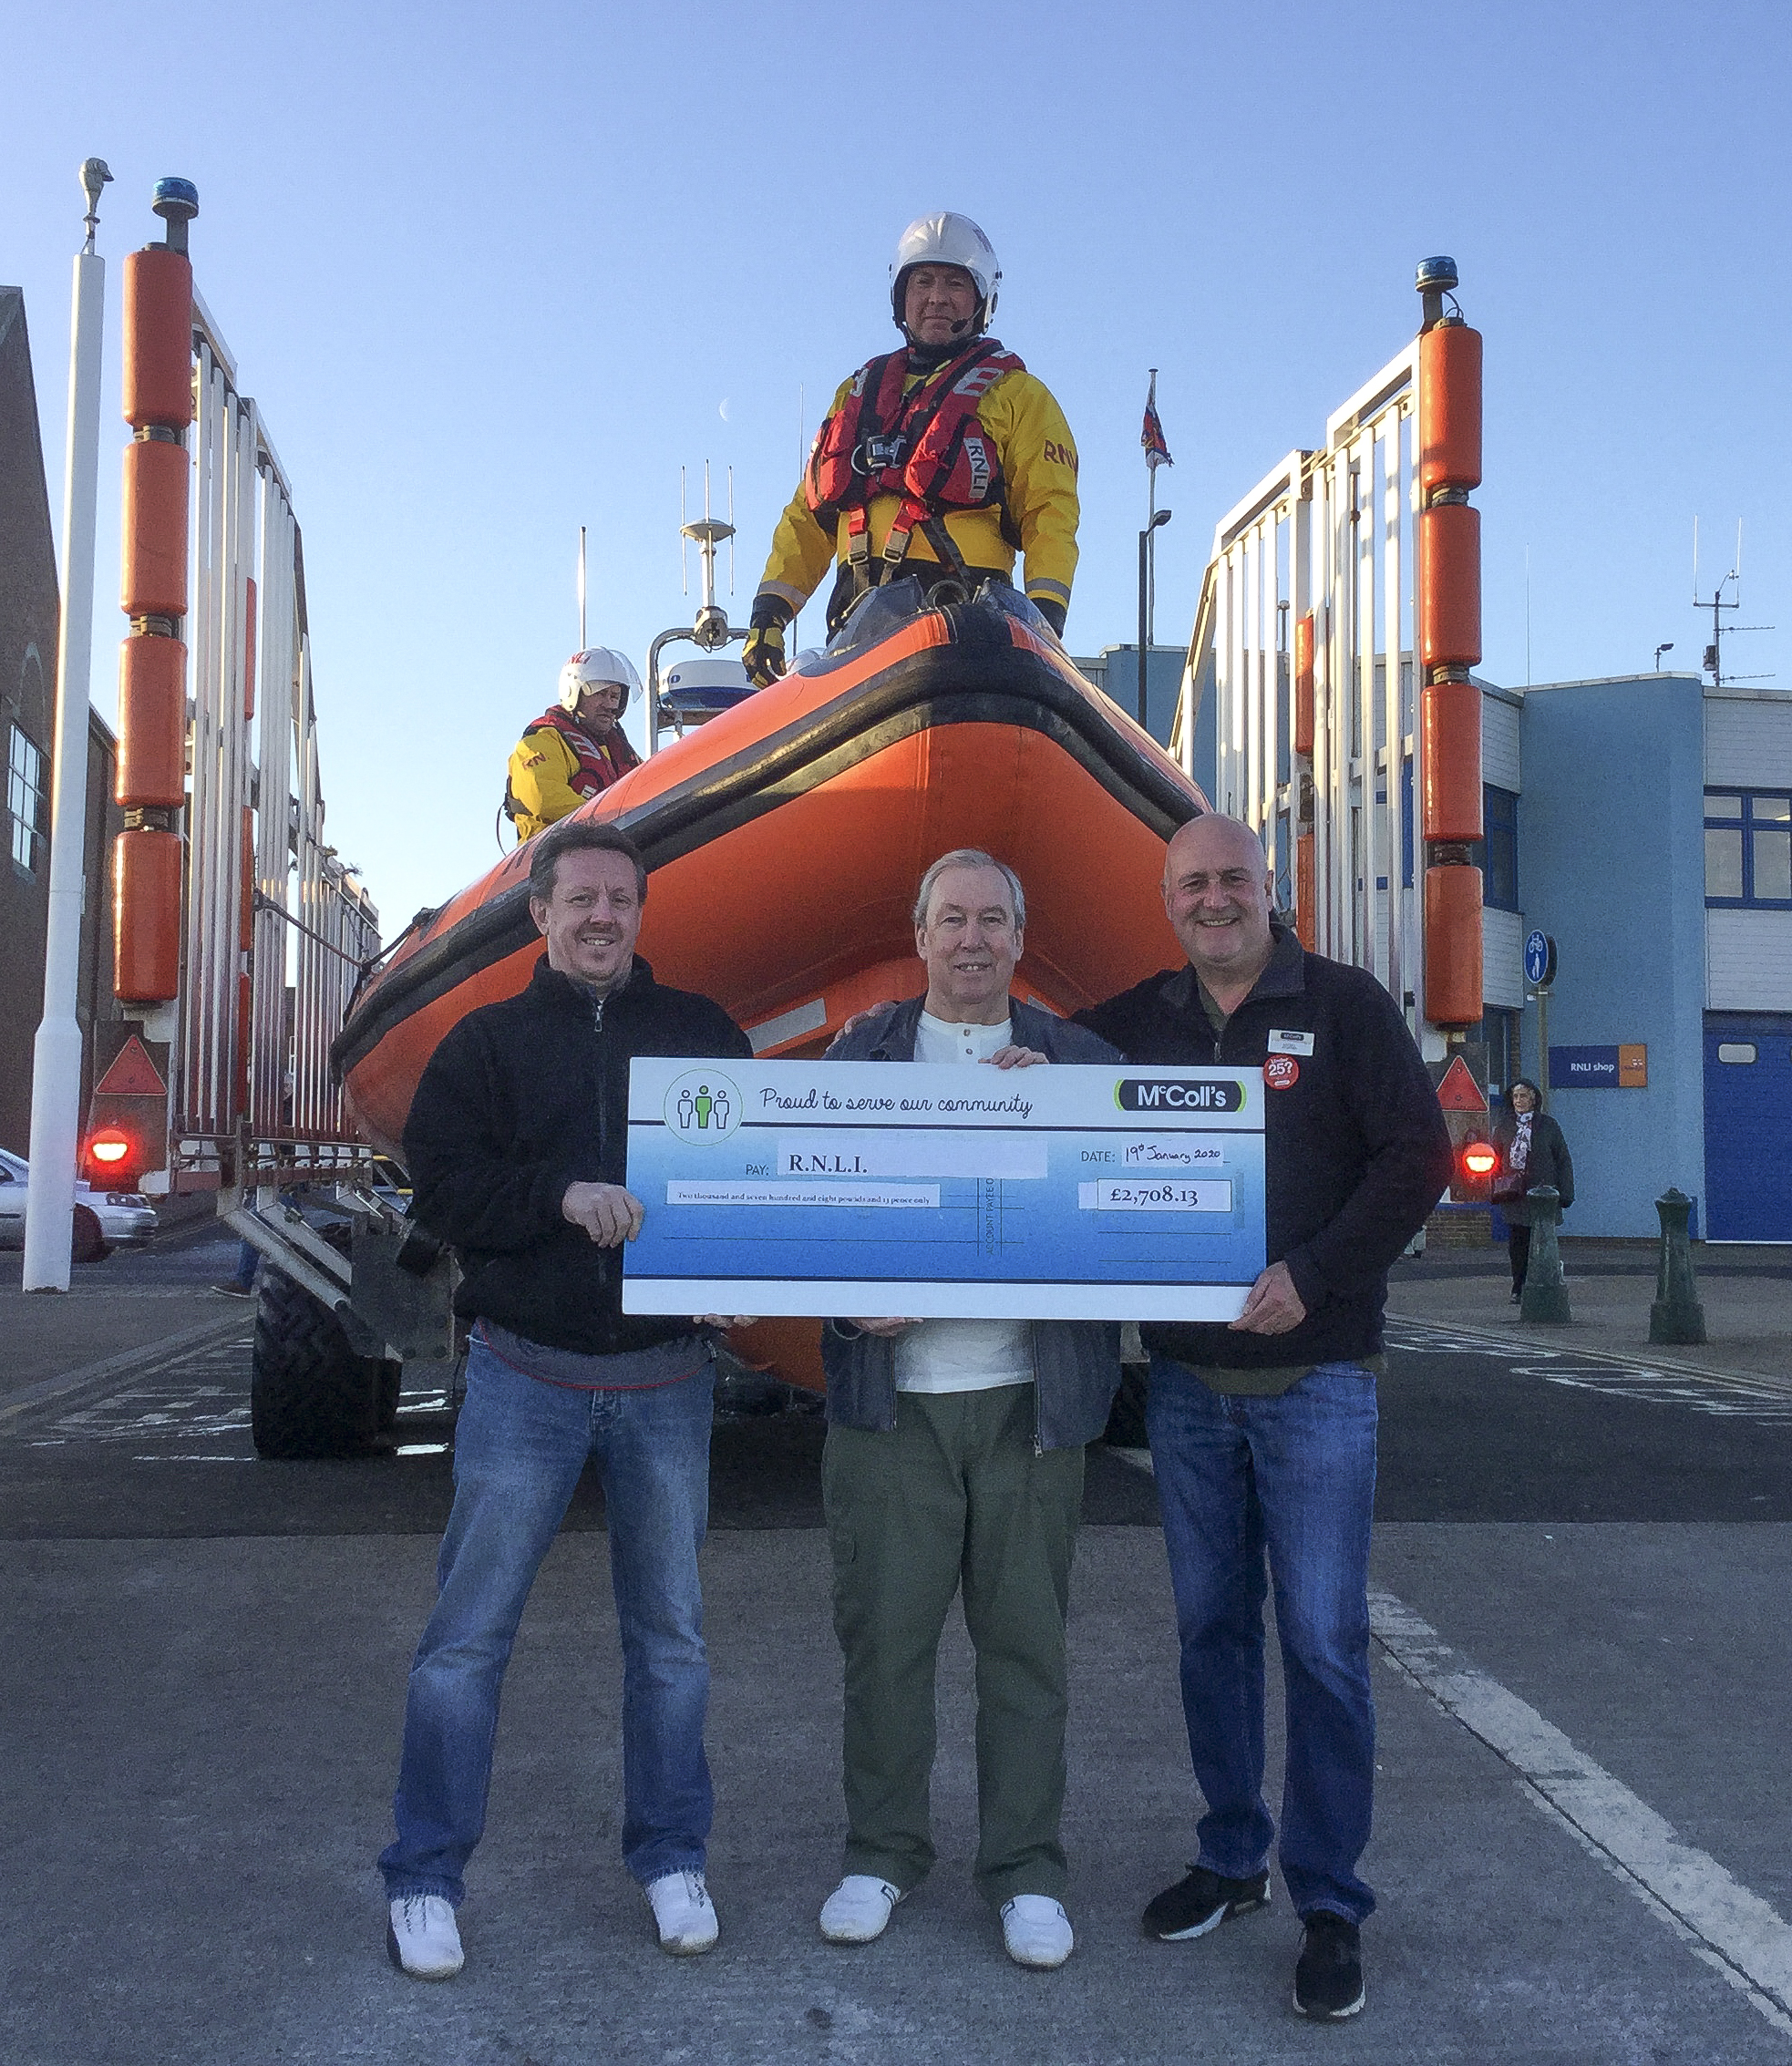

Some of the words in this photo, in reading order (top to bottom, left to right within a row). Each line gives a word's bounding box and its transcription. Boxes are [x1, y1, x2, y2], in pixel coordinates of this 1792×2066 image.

[969, 446, 989, 489] RNLI
[1268, 1062, 1293, 1076] 25?
[1571, 1063, 1591, 1072] RNLI
[1593, 1062, 1615, 1074] shop
[759, 1088, 819, 1109] Proud
[822, 1091, 842, 1109] to
[845, 1096, 896, 1111] serve
[899, 1097, 932, 1111] our
[937, 1094, 1034, 1119] community
[1138, 1084, 1227, 1107] McColl's
[789, 1154, 868, 1173] R.N.L.I.
[1081, 1150, 1116, 1162] DATE:
[1147, 1145, 1190, 1164] January
[1193, 1148, 1220, 1159] 2020
[746, 1164, 769, 1176] PAY:
[986, 1187, 994, 1212] PAYEE
[1110, 1186, 1199, 1207] £2,708.13
[986, 1215, 994, 1255] ACCOUNT
